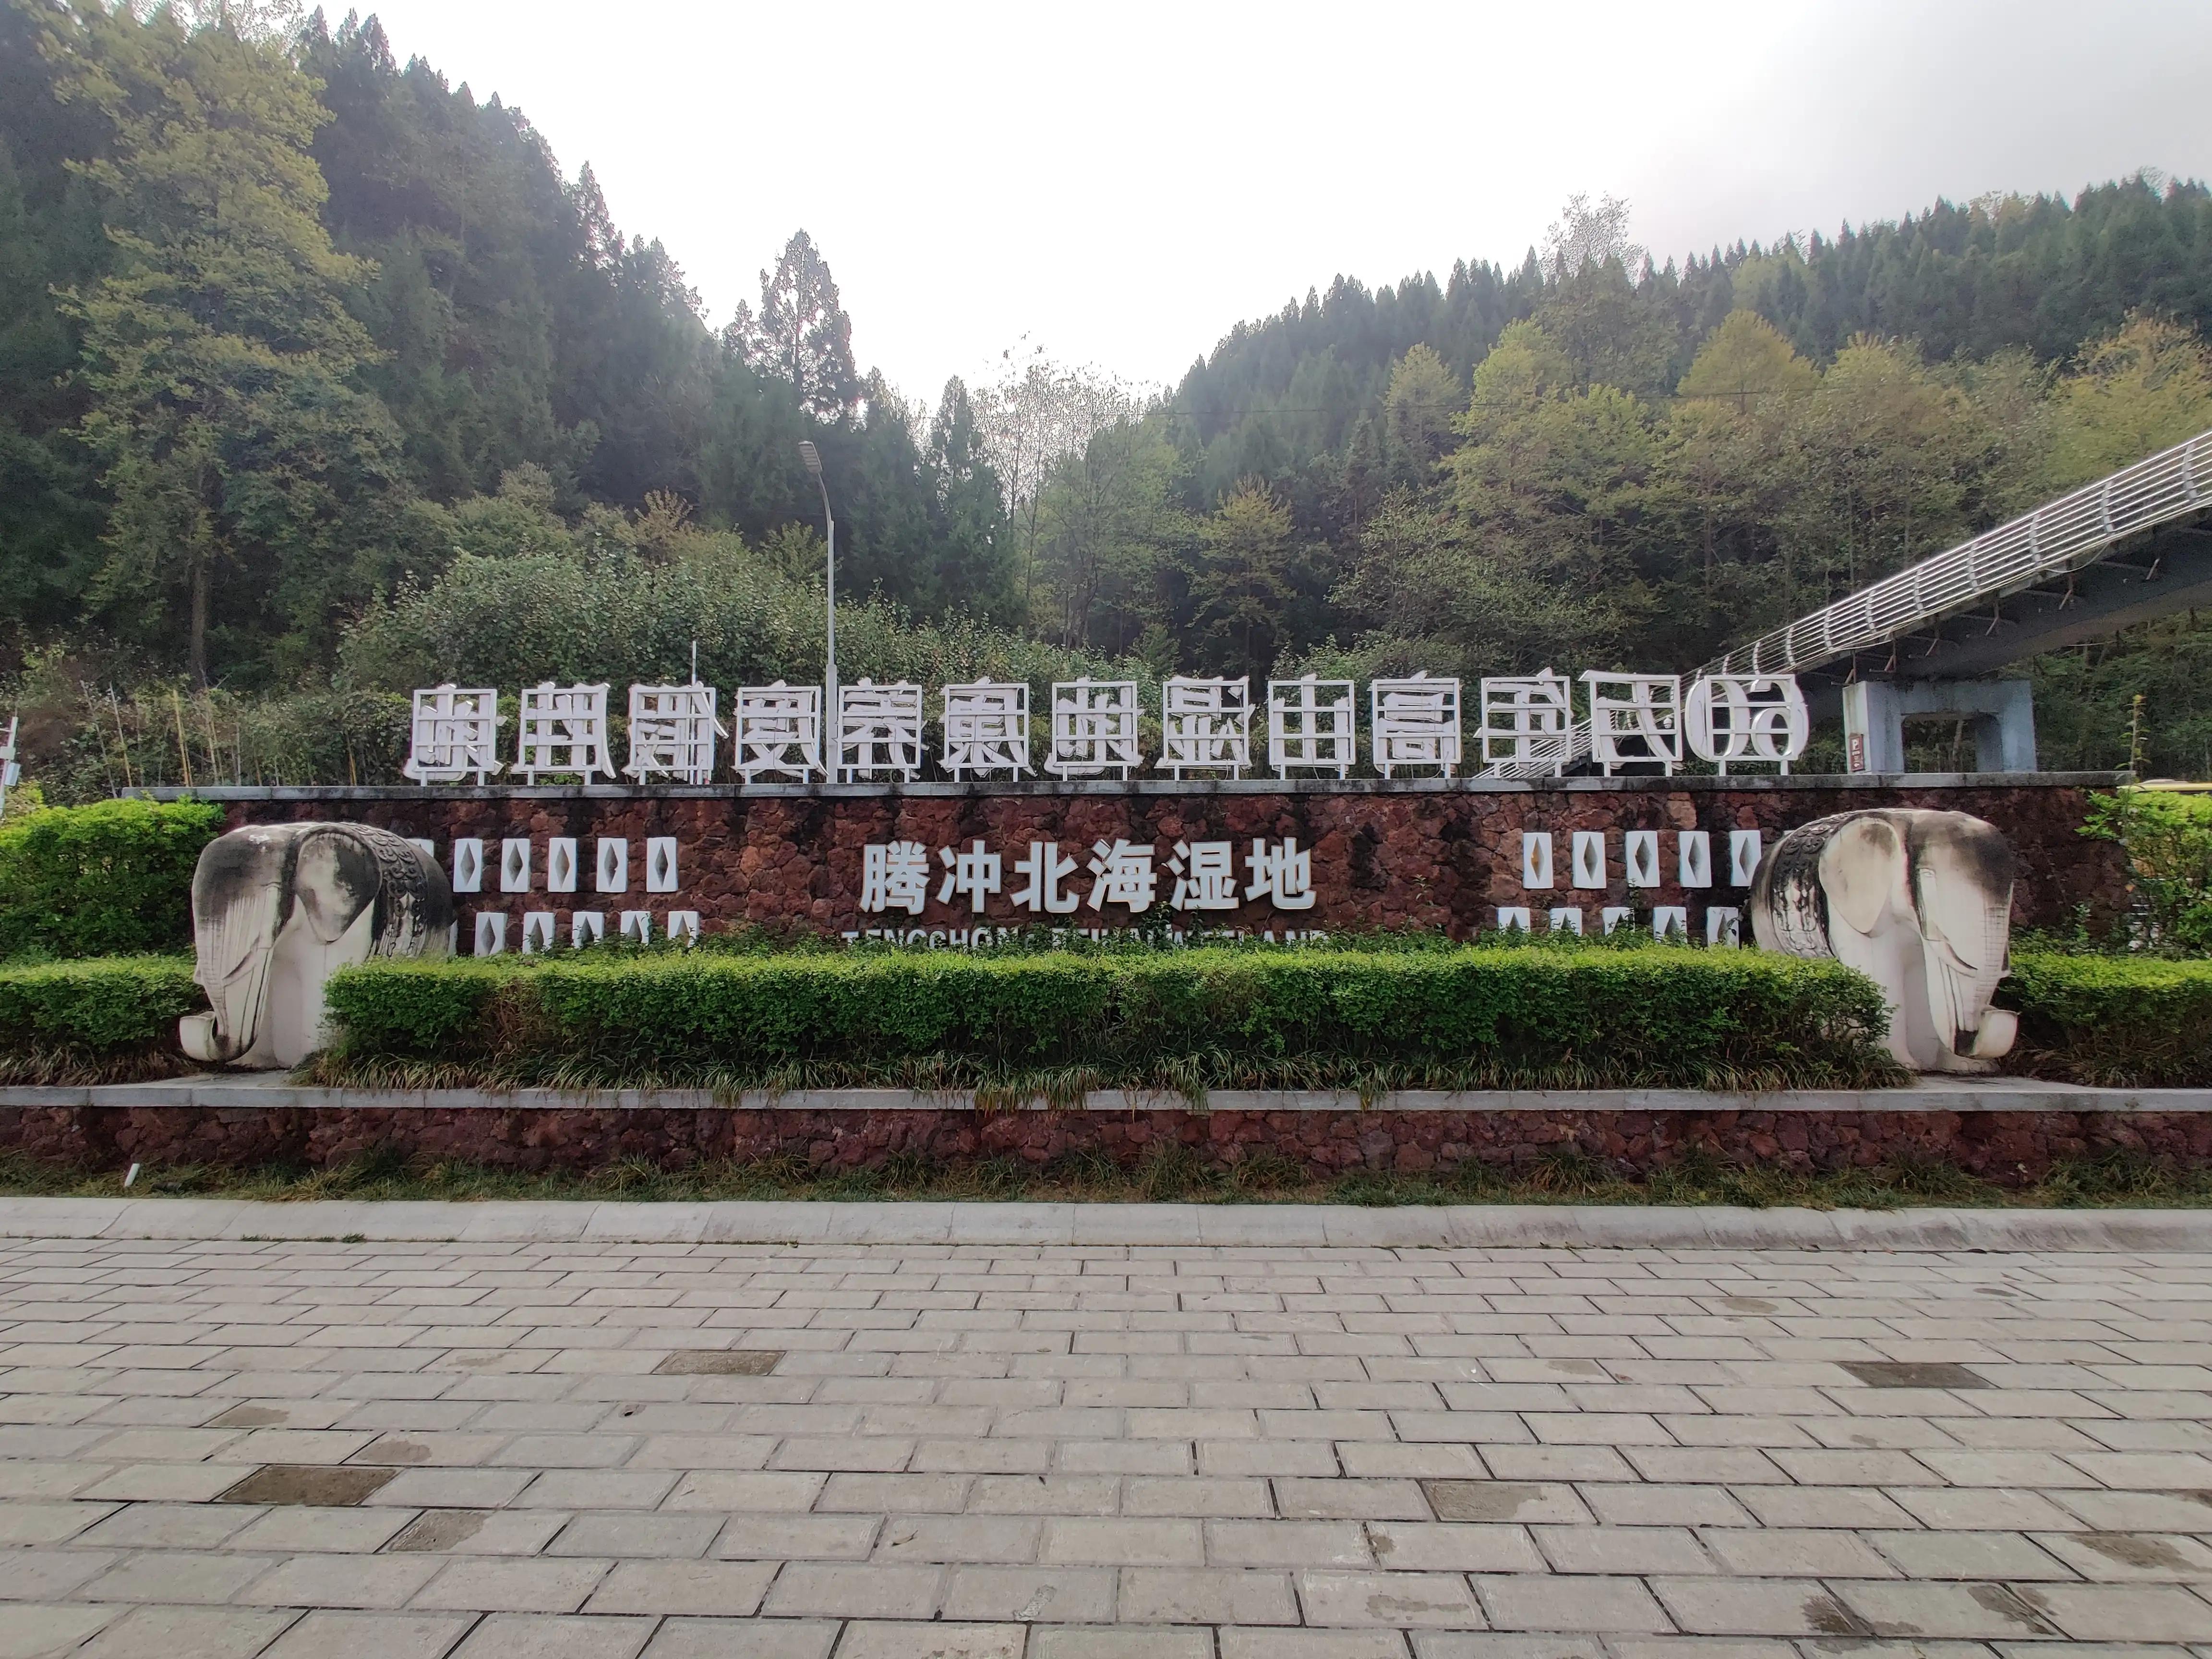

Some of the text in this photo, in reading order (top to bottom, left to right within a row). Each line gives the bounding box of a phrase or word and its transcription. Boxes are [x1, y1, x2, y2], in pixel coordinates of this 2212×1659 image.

[1851, 739, 1858, 749] P
[860, 837, 1317, 915] 腾冲北海湿地
